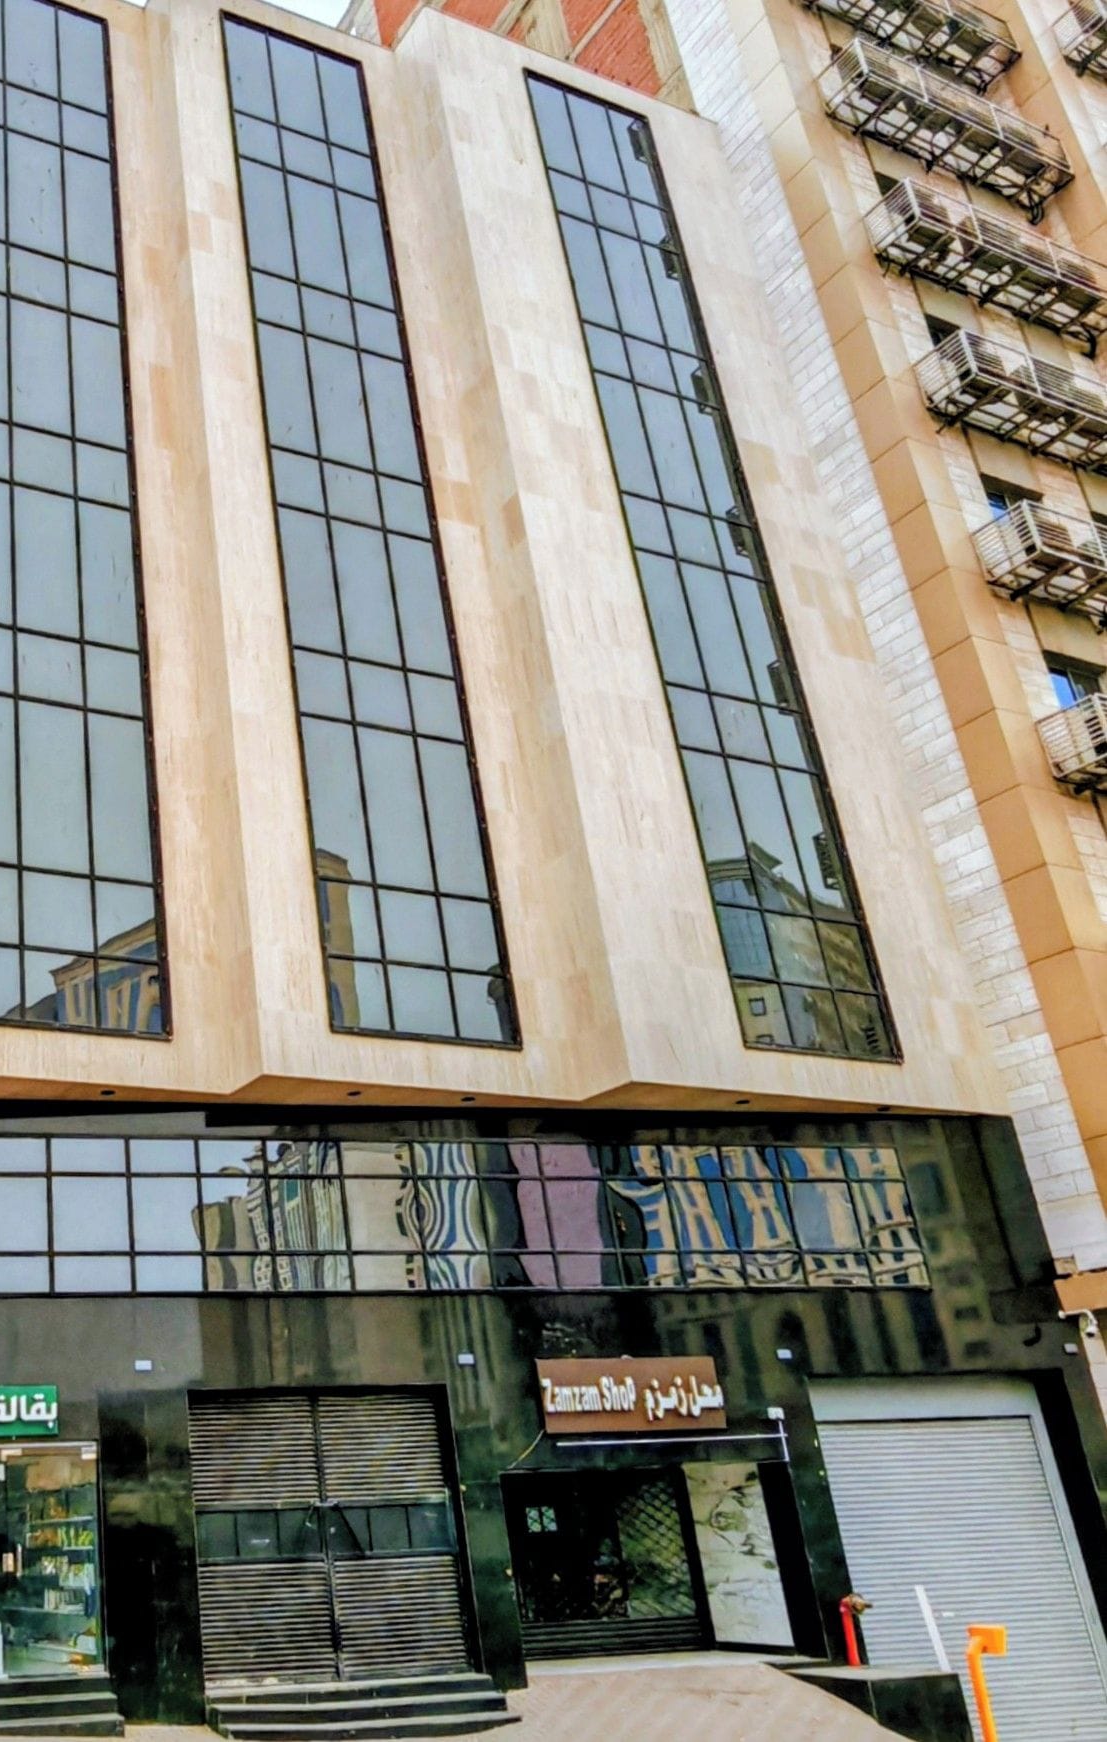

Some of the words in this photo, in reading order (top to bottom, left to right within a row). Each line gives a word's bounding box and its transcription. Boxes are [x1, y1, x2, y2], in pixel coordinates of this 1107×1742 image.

[541, 1377, 603, 1414] Zamzam
[644, 1375, 689, 1422] زمزم
[688, 1375, 724, 1418] محل
